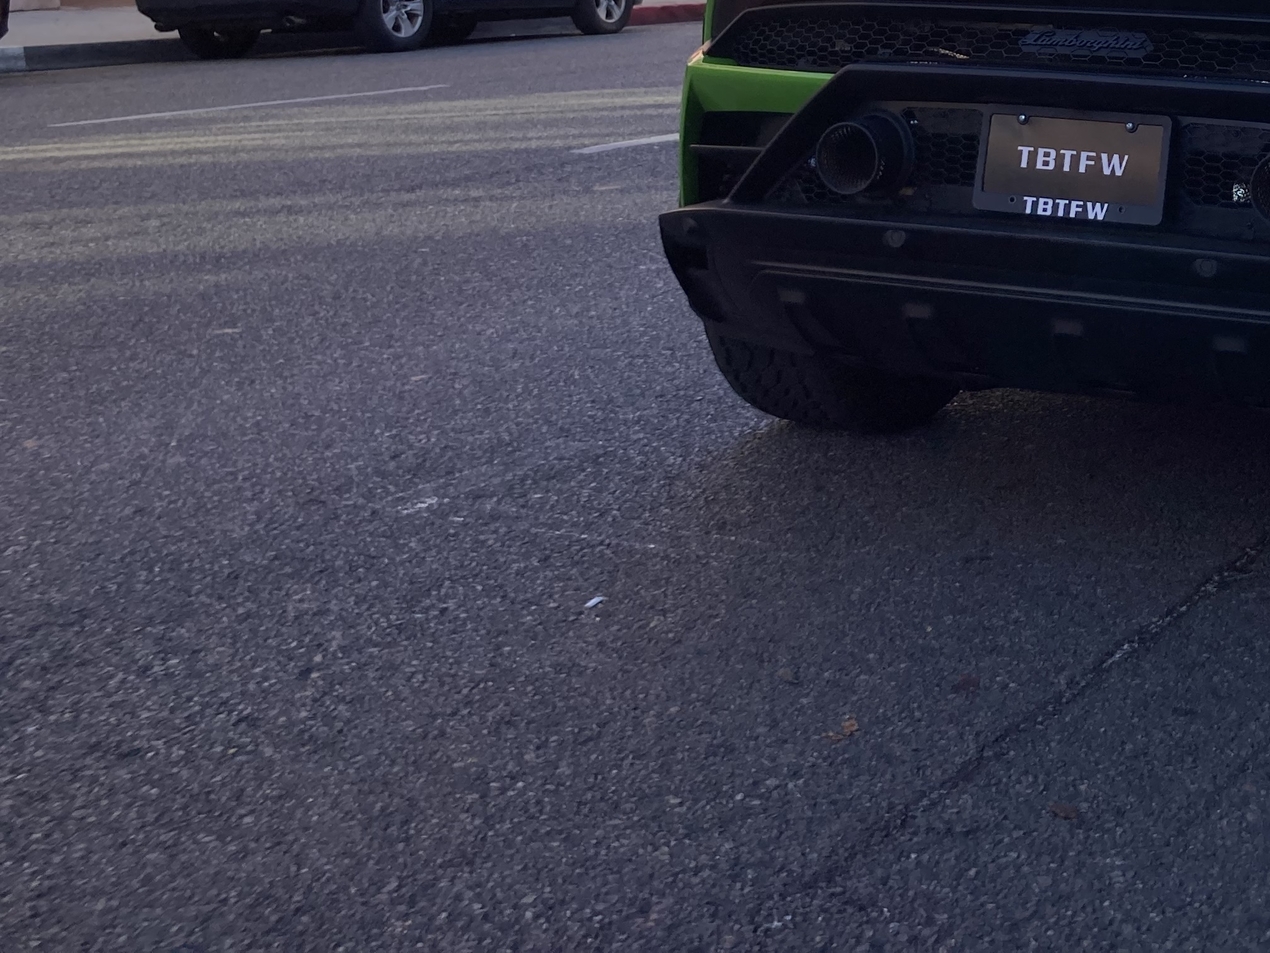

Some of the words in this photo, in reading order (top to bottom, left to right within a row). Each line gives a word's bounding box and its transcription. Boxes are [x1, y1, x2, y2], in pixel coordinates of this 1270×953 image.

[1020, 30, 1146, 51] Lamborghini
[1017, 146, 1129, 176] TBTFW
[1023, 196, 1109, 221] TBTFW
